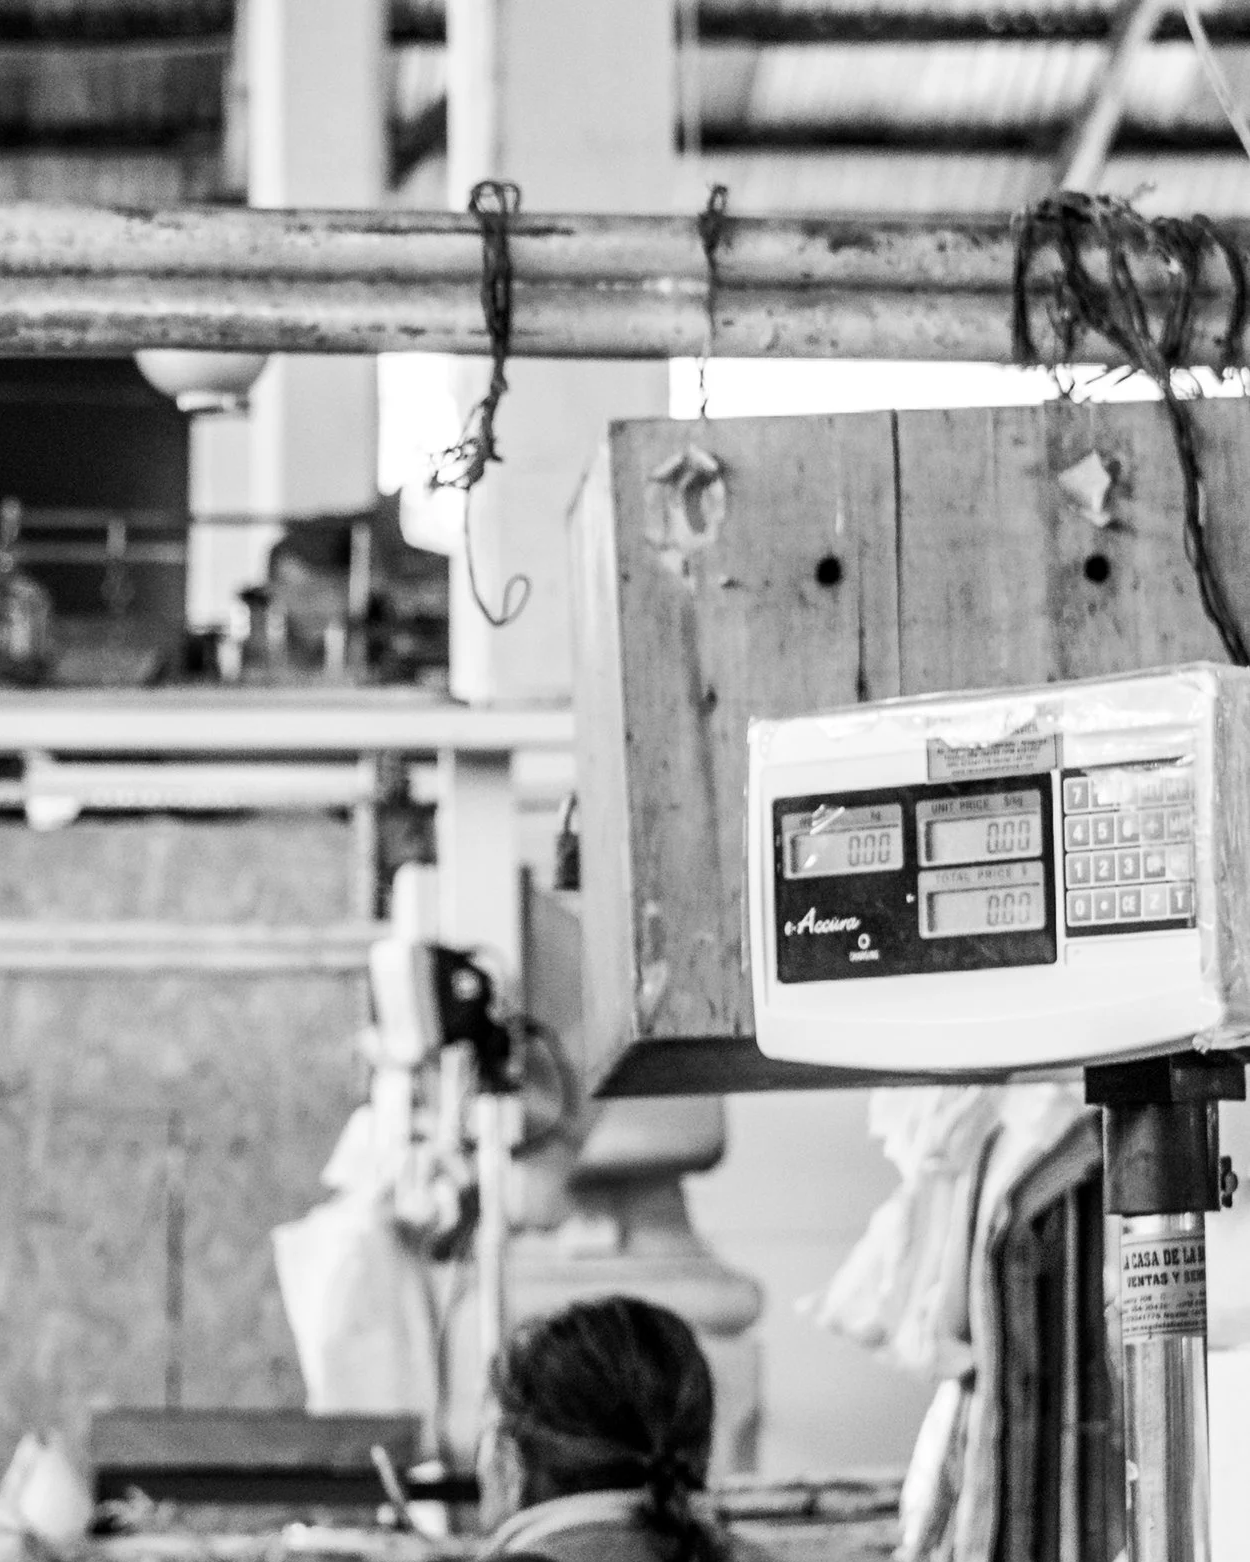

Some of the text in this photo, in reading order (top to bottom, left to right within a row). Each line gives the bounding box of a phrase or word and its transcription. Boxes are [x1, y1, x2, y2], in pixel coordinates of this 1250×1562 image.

[1072, 786, 1082, 805] 7
[931, 803, 954, 816] UNIT
[959, 798, 989, 812] PRICE
[1072, 824, 1083, 842] 4
[1097, 821, 1107, 840] 5
[936, 870, 971, 886] TOTAL
[977, 865, 1012, 881] PRICE
[1074, 860, 1083, 879] 1
[1100, 859, 1110, 878] 2
[1123, 856, 1134, 876] 3
[1132, 1251, 1159, 1268] CASA
[1163, 1247, 1180, 1265] DE
[1127, 1272, 1168, 1287] VENTAS
[1172, 1272, 1180, 1284] Y
